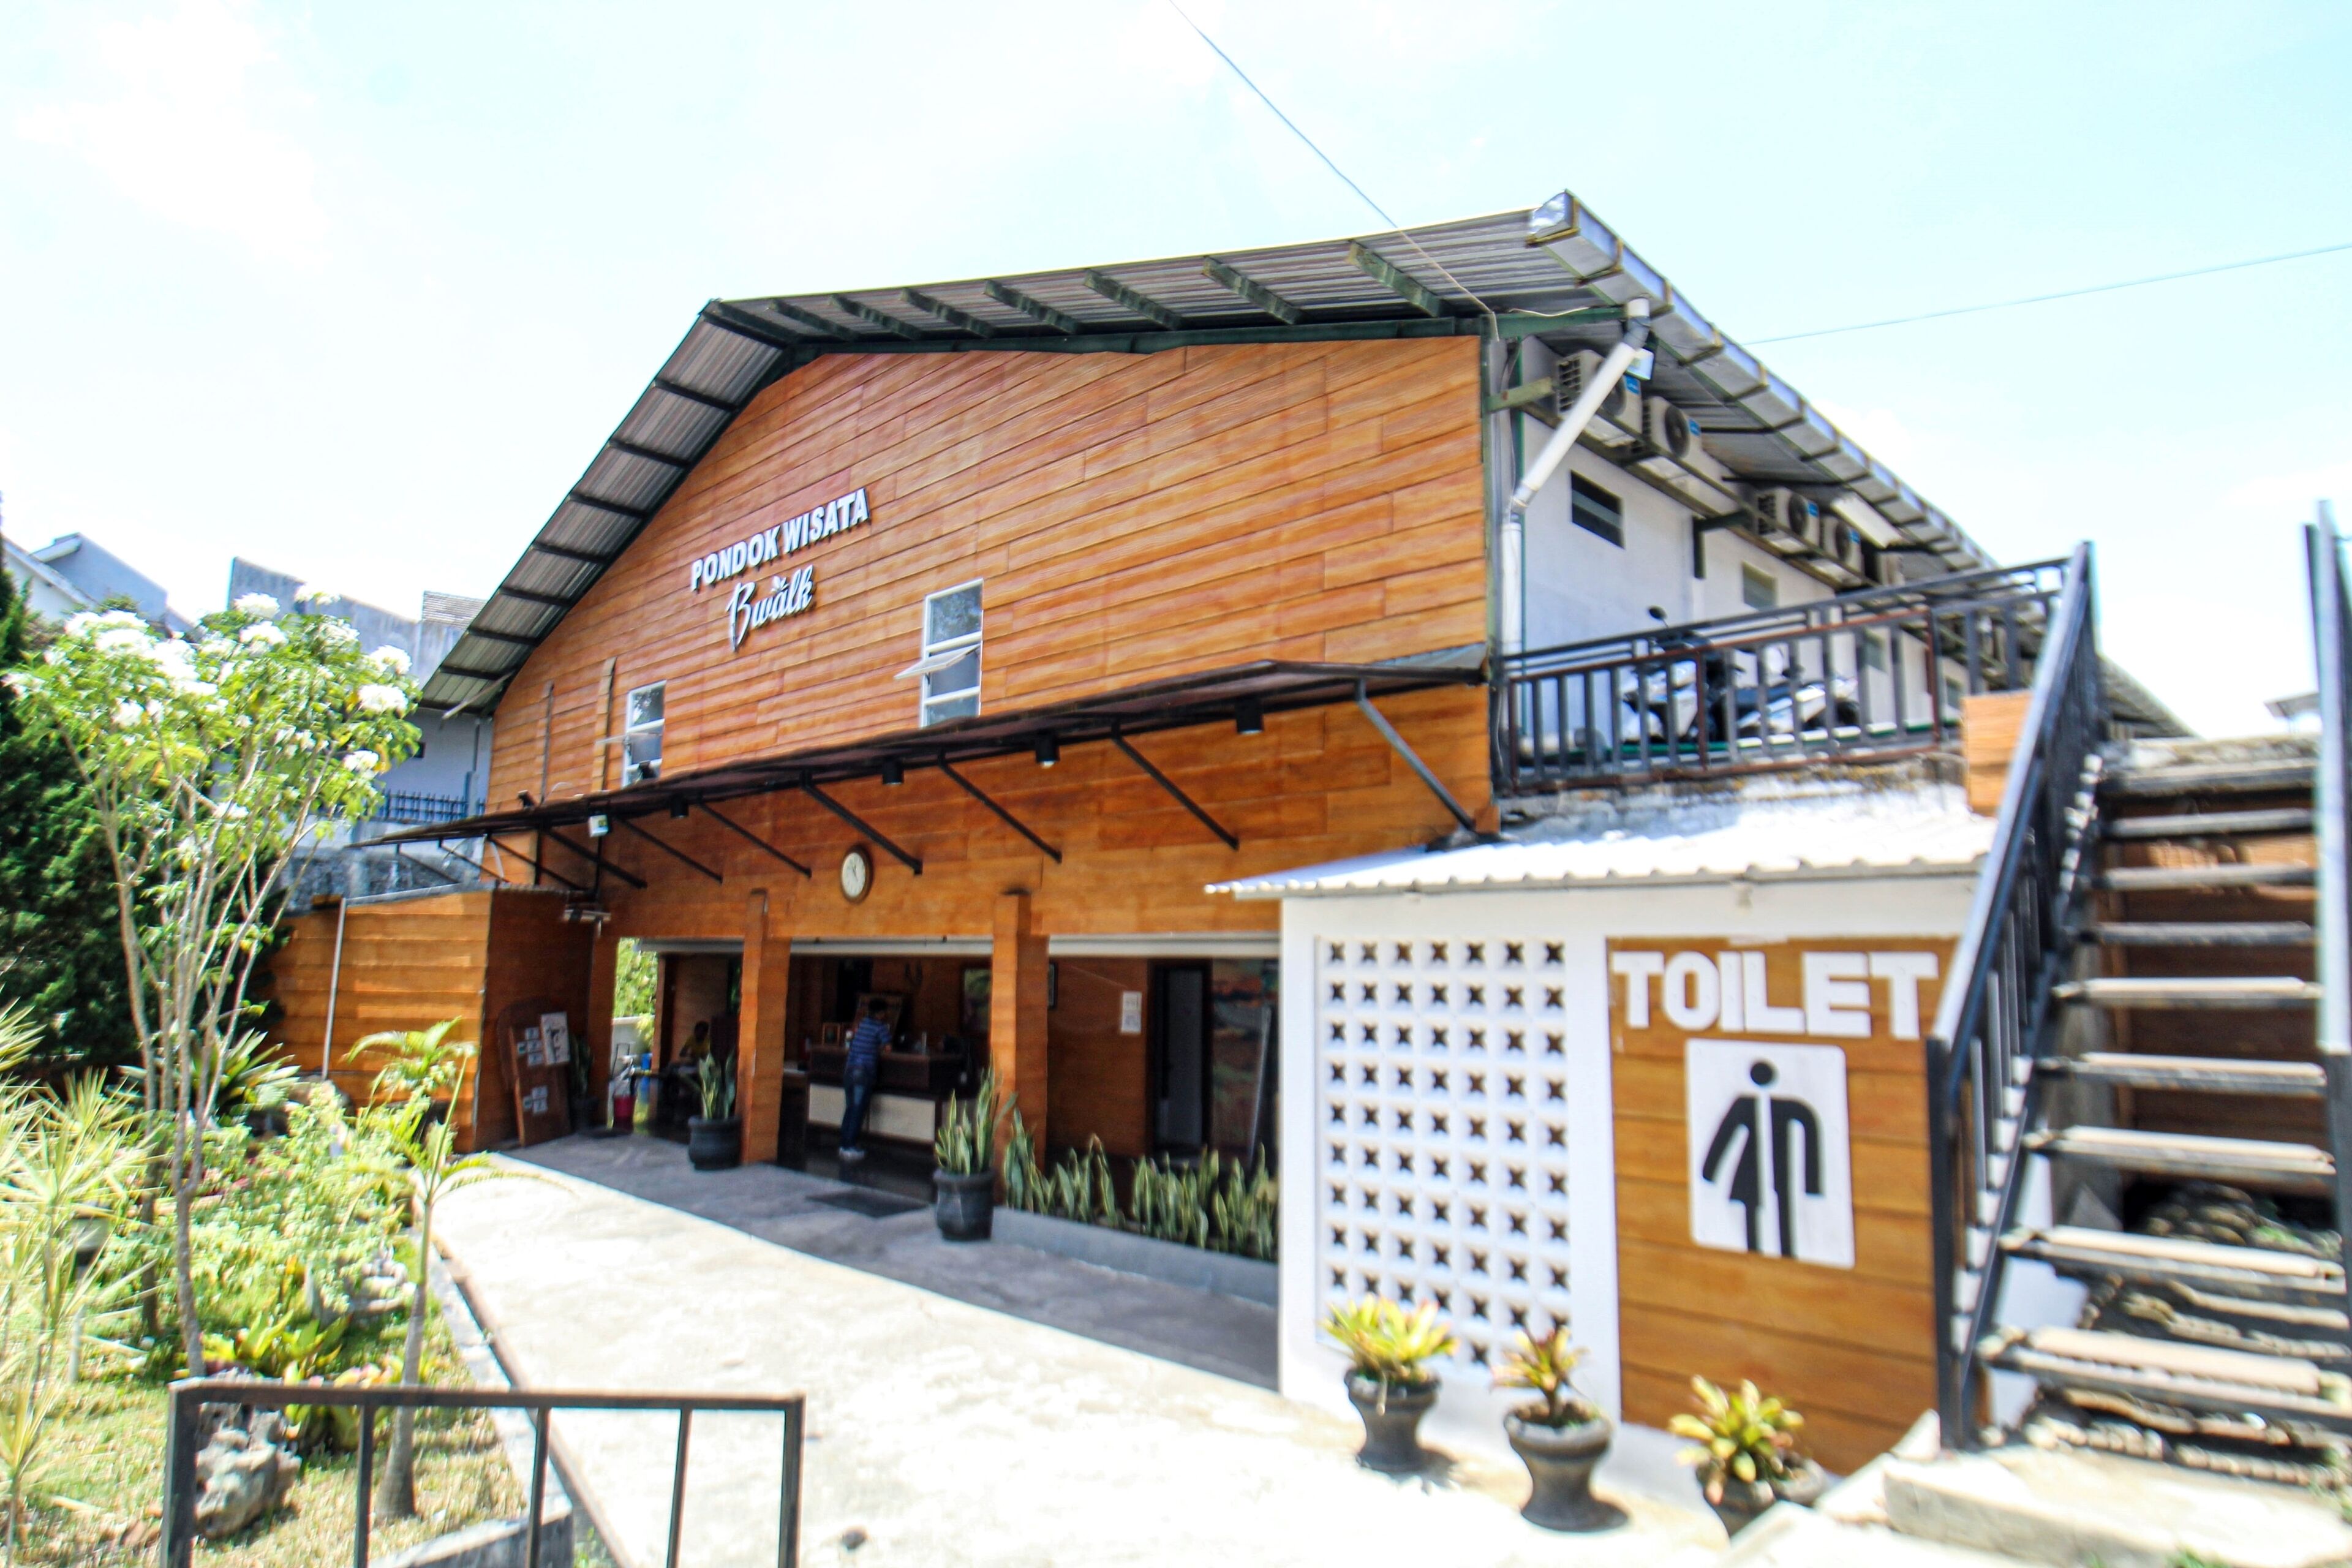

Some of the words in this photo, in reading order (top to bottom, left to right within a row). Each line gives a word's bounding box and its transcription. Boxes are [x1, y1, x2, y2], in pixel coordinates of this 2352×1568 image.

[691, 526, 780, 592] PONDOK
[782, 488, 869, 555] WISATA
[726, 565, 813, 652] Bwalk
[1612, 951, 1939, 1039] TOILET
